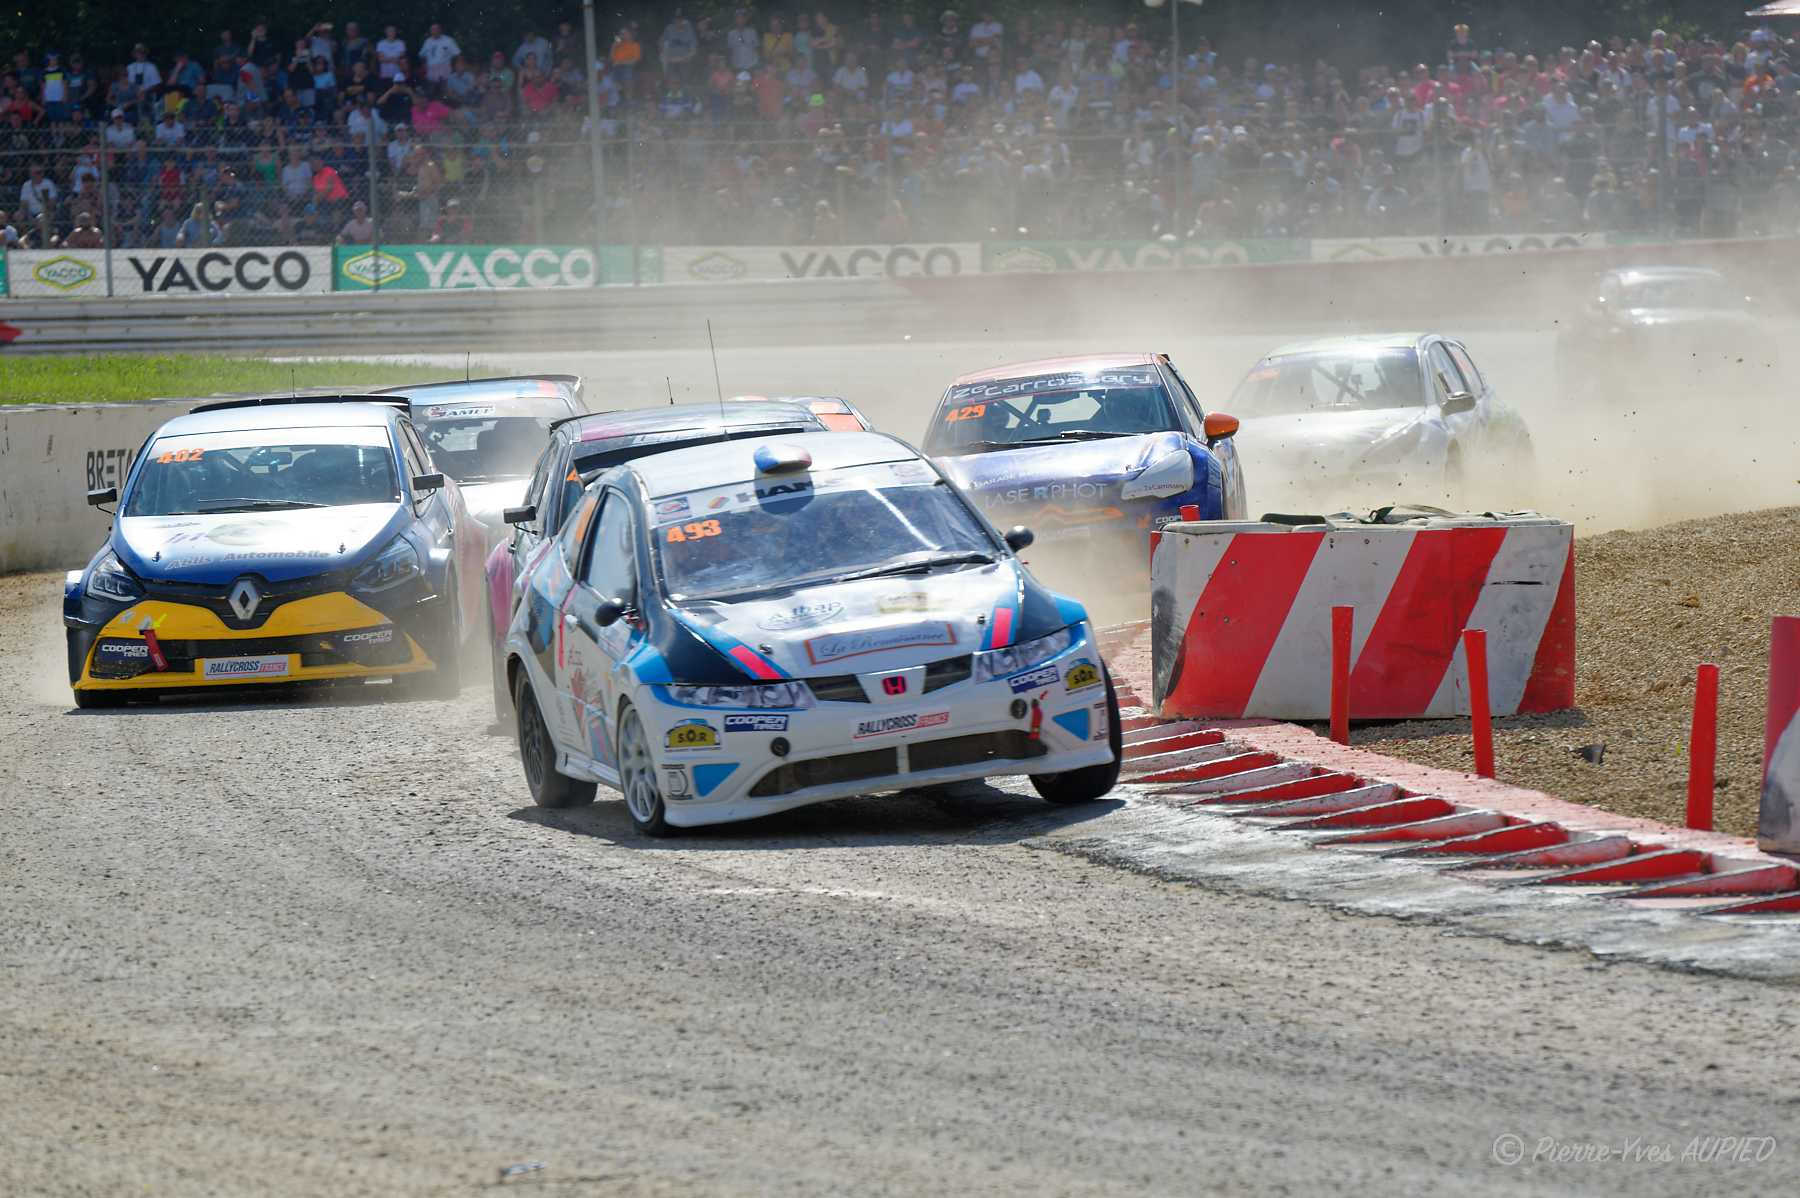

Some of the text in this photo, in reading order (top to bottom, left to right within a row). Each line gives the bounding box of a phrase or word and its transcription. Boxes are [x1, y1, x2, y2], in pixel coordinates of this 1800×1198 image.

[128, 252, 310, 292] YACCO
[416, 249, 596, 289] YACCO
[780, 247, 961, 279] YACCO
[45, 266, 88, 280] YACCO
[944, 404, 987, 423] 429
[156, 448, 204, 465] 402
[666, 519, 722, 544] 493
[224, 550, 331, 563] Automobile
[343, 630, 393, 642] COOPER
[209, 661, 259, 673] RALLYCROSS
[1008, 667, 1058, 688] COOPER
[725, 716, 786, 724] COOPER
[858, 713, 917, 735] RALLYCROSS
